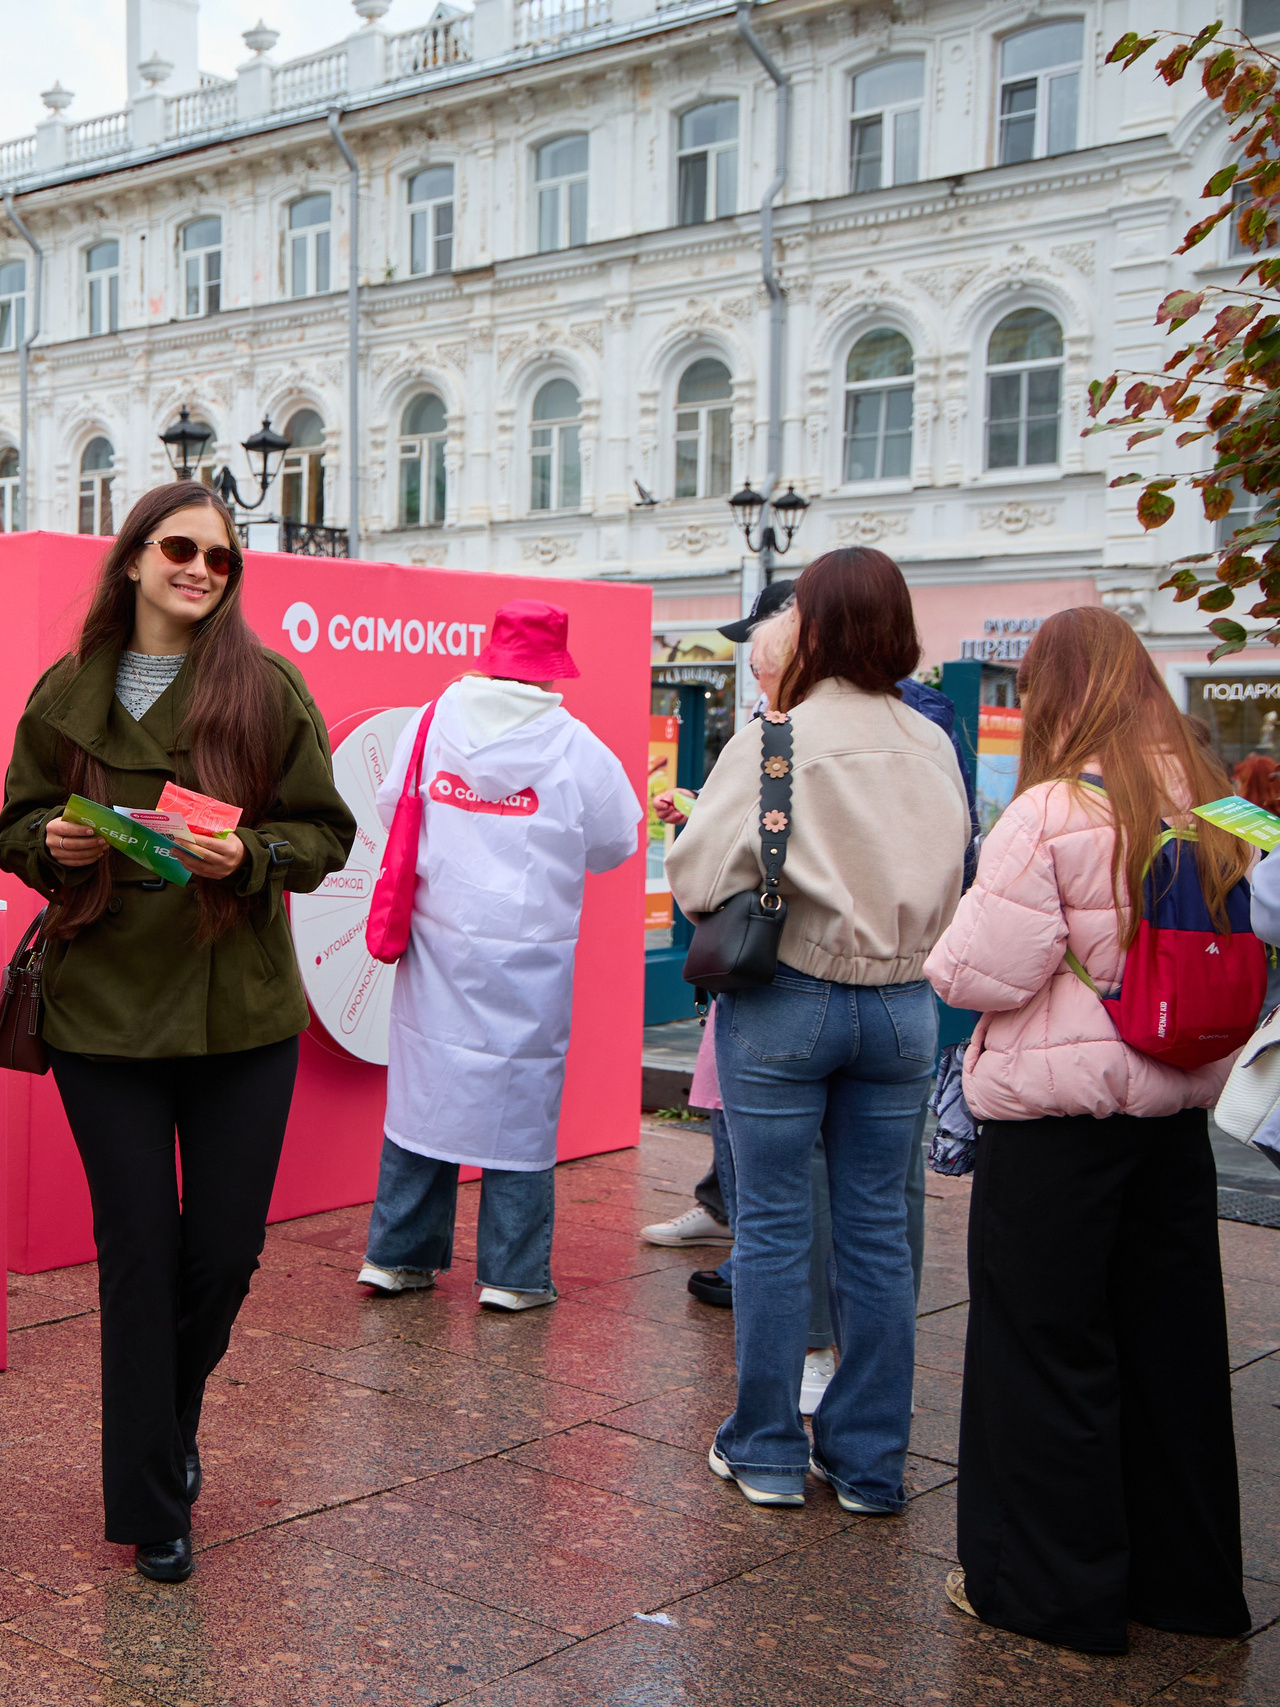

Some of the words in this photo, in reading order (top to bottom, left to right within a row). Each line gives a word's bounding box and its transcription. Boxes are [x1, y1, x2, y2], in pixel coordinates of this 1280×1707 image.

[328, 614, 486, 656] самокат
[369, 746, 384, 786] ПРОМ
[100, 827, 138, 844] СБЕР
[323, 876, 364, 890] ОМОКОД
[347, 958, 379, 1022] ПРОМОКО
[1160, 1001, 1168, 1012] KID
[1158, 1012, 1167, 1038] ARPENAZ
